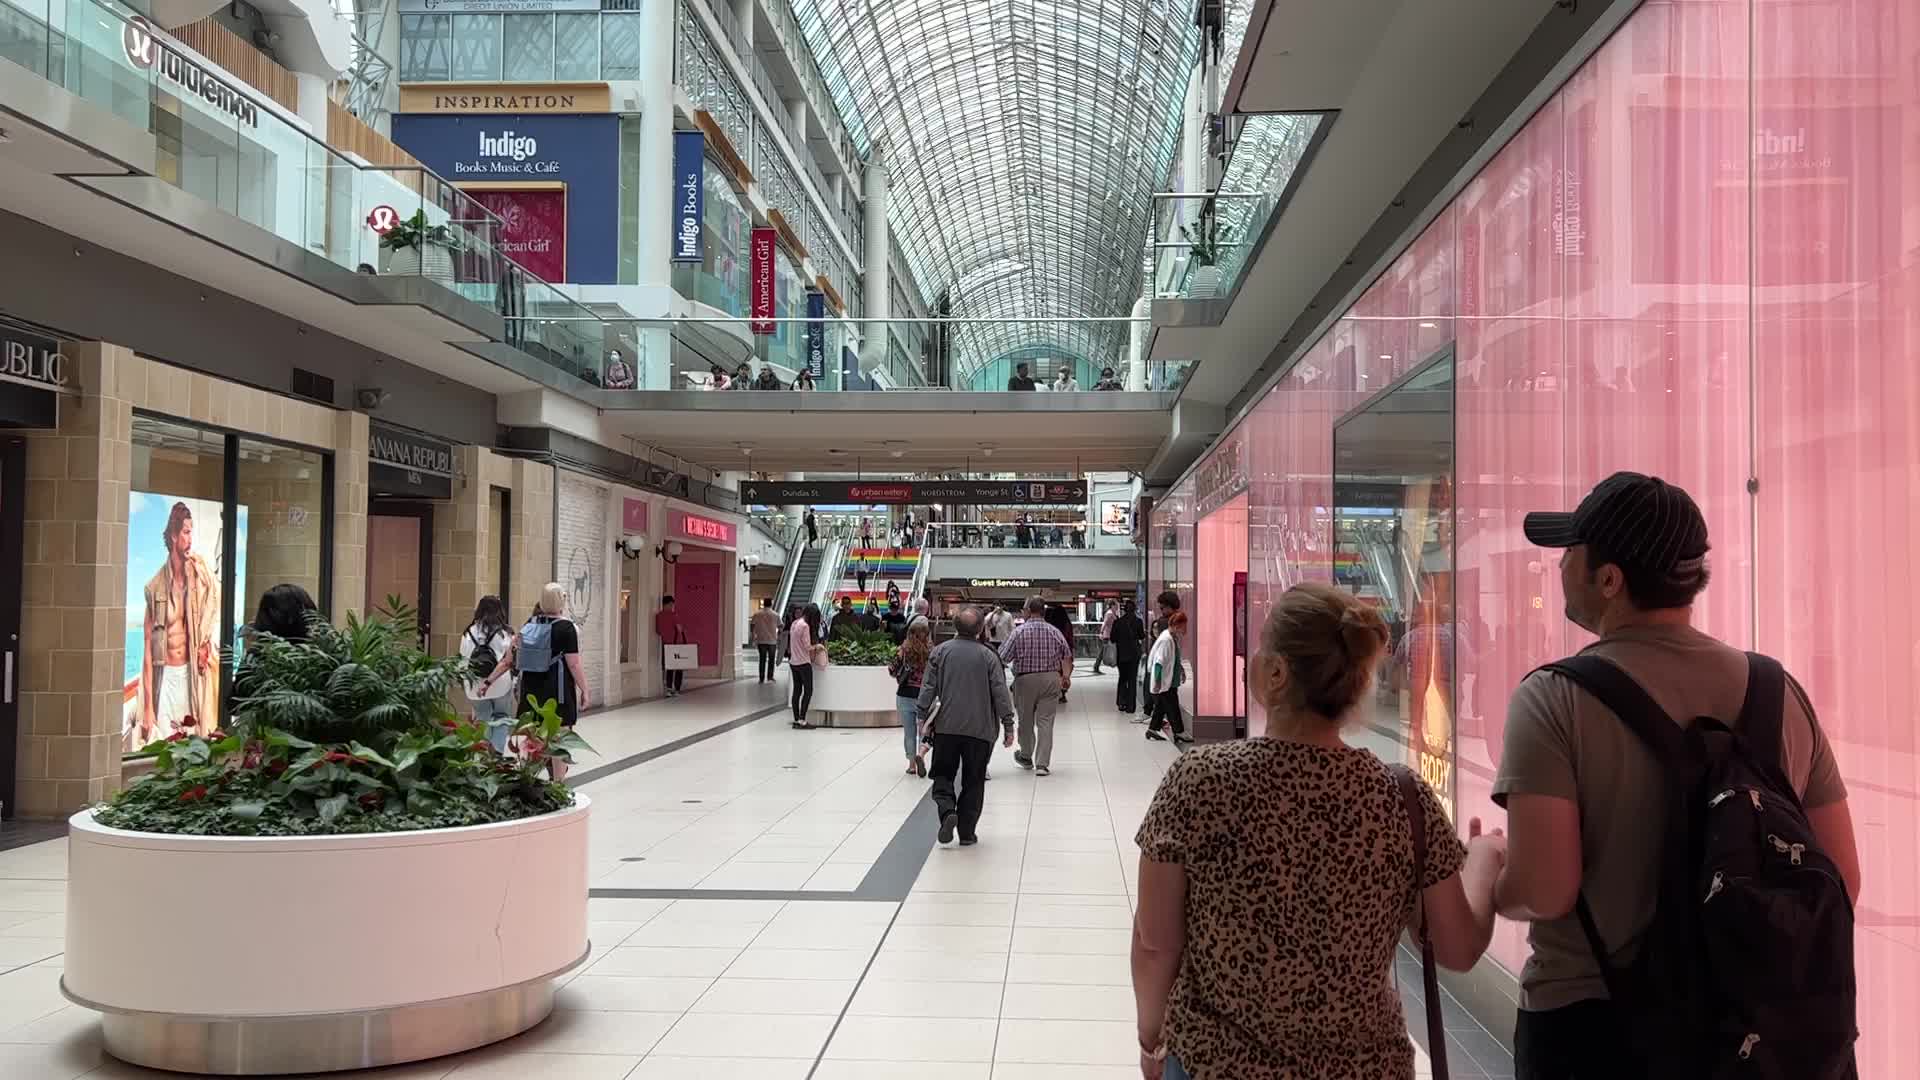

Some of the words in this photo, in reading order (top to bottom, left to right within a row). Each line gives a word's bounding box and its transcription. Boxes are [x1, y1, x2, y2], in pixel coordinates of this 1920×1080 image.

[158, 45, 258, 129] lululemon
[434, 95, 575, 109] INSPIRATION
[455, 161, 488, 173] Books
[490, 161, 521, 173] Music
[523, 162, 536, 174] &
[535, 161, 561, 173] Café
[682, 172, 697, 214] Books
[757, 239, 770, 261] Girl
[758, 262, 770, 313] American
[781, 488, 810, 498] Dundas
[920, 488, 967, 497] NORDSTROM
[971, 579, 995, 587] Guest
[996, 579, 1029, 587] Services
[1420, 751, 1451, 793] BODY
